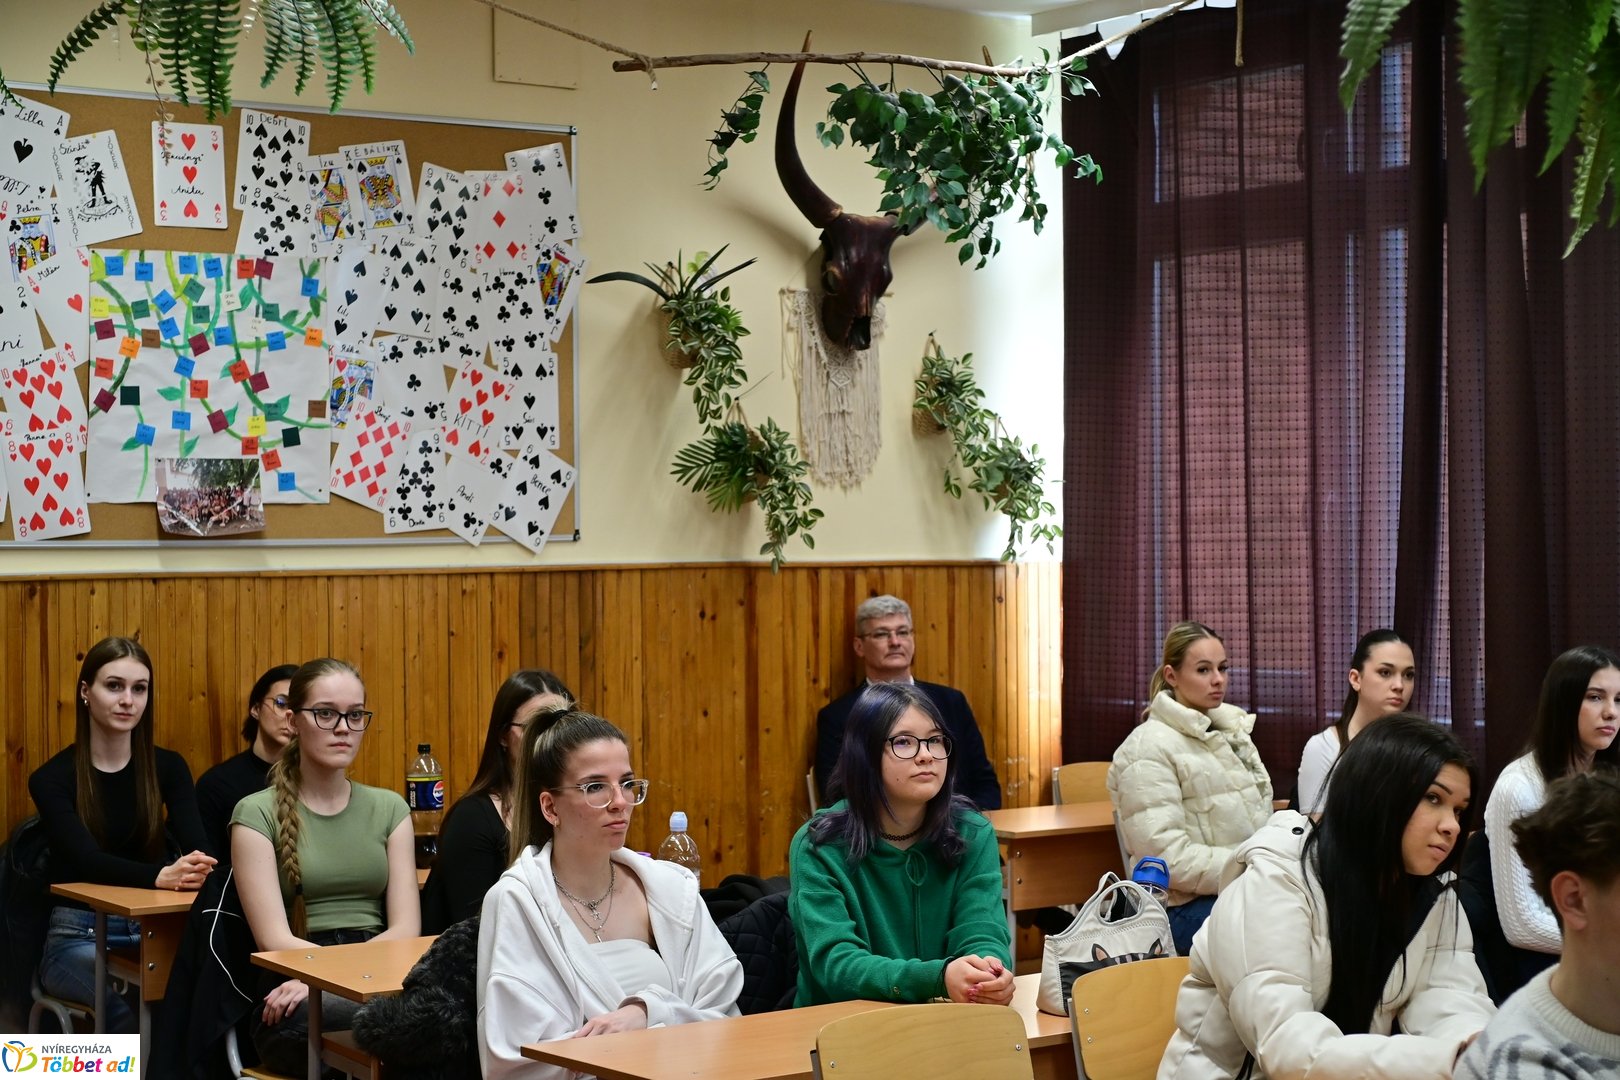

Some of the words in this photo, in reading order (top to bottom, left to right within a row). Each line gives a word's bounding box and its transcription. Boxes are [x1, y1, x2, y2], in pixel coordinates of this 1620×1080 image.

[15, 106, 45, 127] Lilla
[57, 115, 63, 126] A
[246, 114, 254, 125] 10
[211, 130, 218, 142] 3
[298, 125, 305, 136] 10
[344, 150, 352, 161] K
[554, 149, 561, 159] 3
[510, 157, 518, 168] 3
[426, 167, 434, 178] 9
[516, 174, 523, 185] 5
[253, 187, 261, 198] 8
[474, 183, 480, 193] 9
[51, 203, 59, 214] K
[304, 204, 311, 214] 8
[381, 235, 388, 245] 7
[336, 244, 344, 255] 3
[430, 244, 437, 255] 7
[383, 266, 390, 277] 3
[444, 268, 450, 278] 6
[527, 265, 534, 275] 7
[482, 272, 489, 282] 7
[17, 286, 26, 298] 2
[378, 342, 386, 352] 5
[503, 357, 509, 368] 5
[548, 358, 554, 368] 5
[508, 383, 515, 393] 7
[6, 419, 13, 430] 6
[454, 413, 491, 438] KITTI
[65, 432, 72, 443] 8
[433, 433, 440, 444] 9
[8, 440, 16, 452] 8
[526, 444, 533, 454] 6
[565, 471, 572, 480] 6
[530, 474, 552, 495] Bence
[456, 485, 475, 503] Andi
[77, 516, 85, 528] 8
[20, 526, 27, 537] 8
